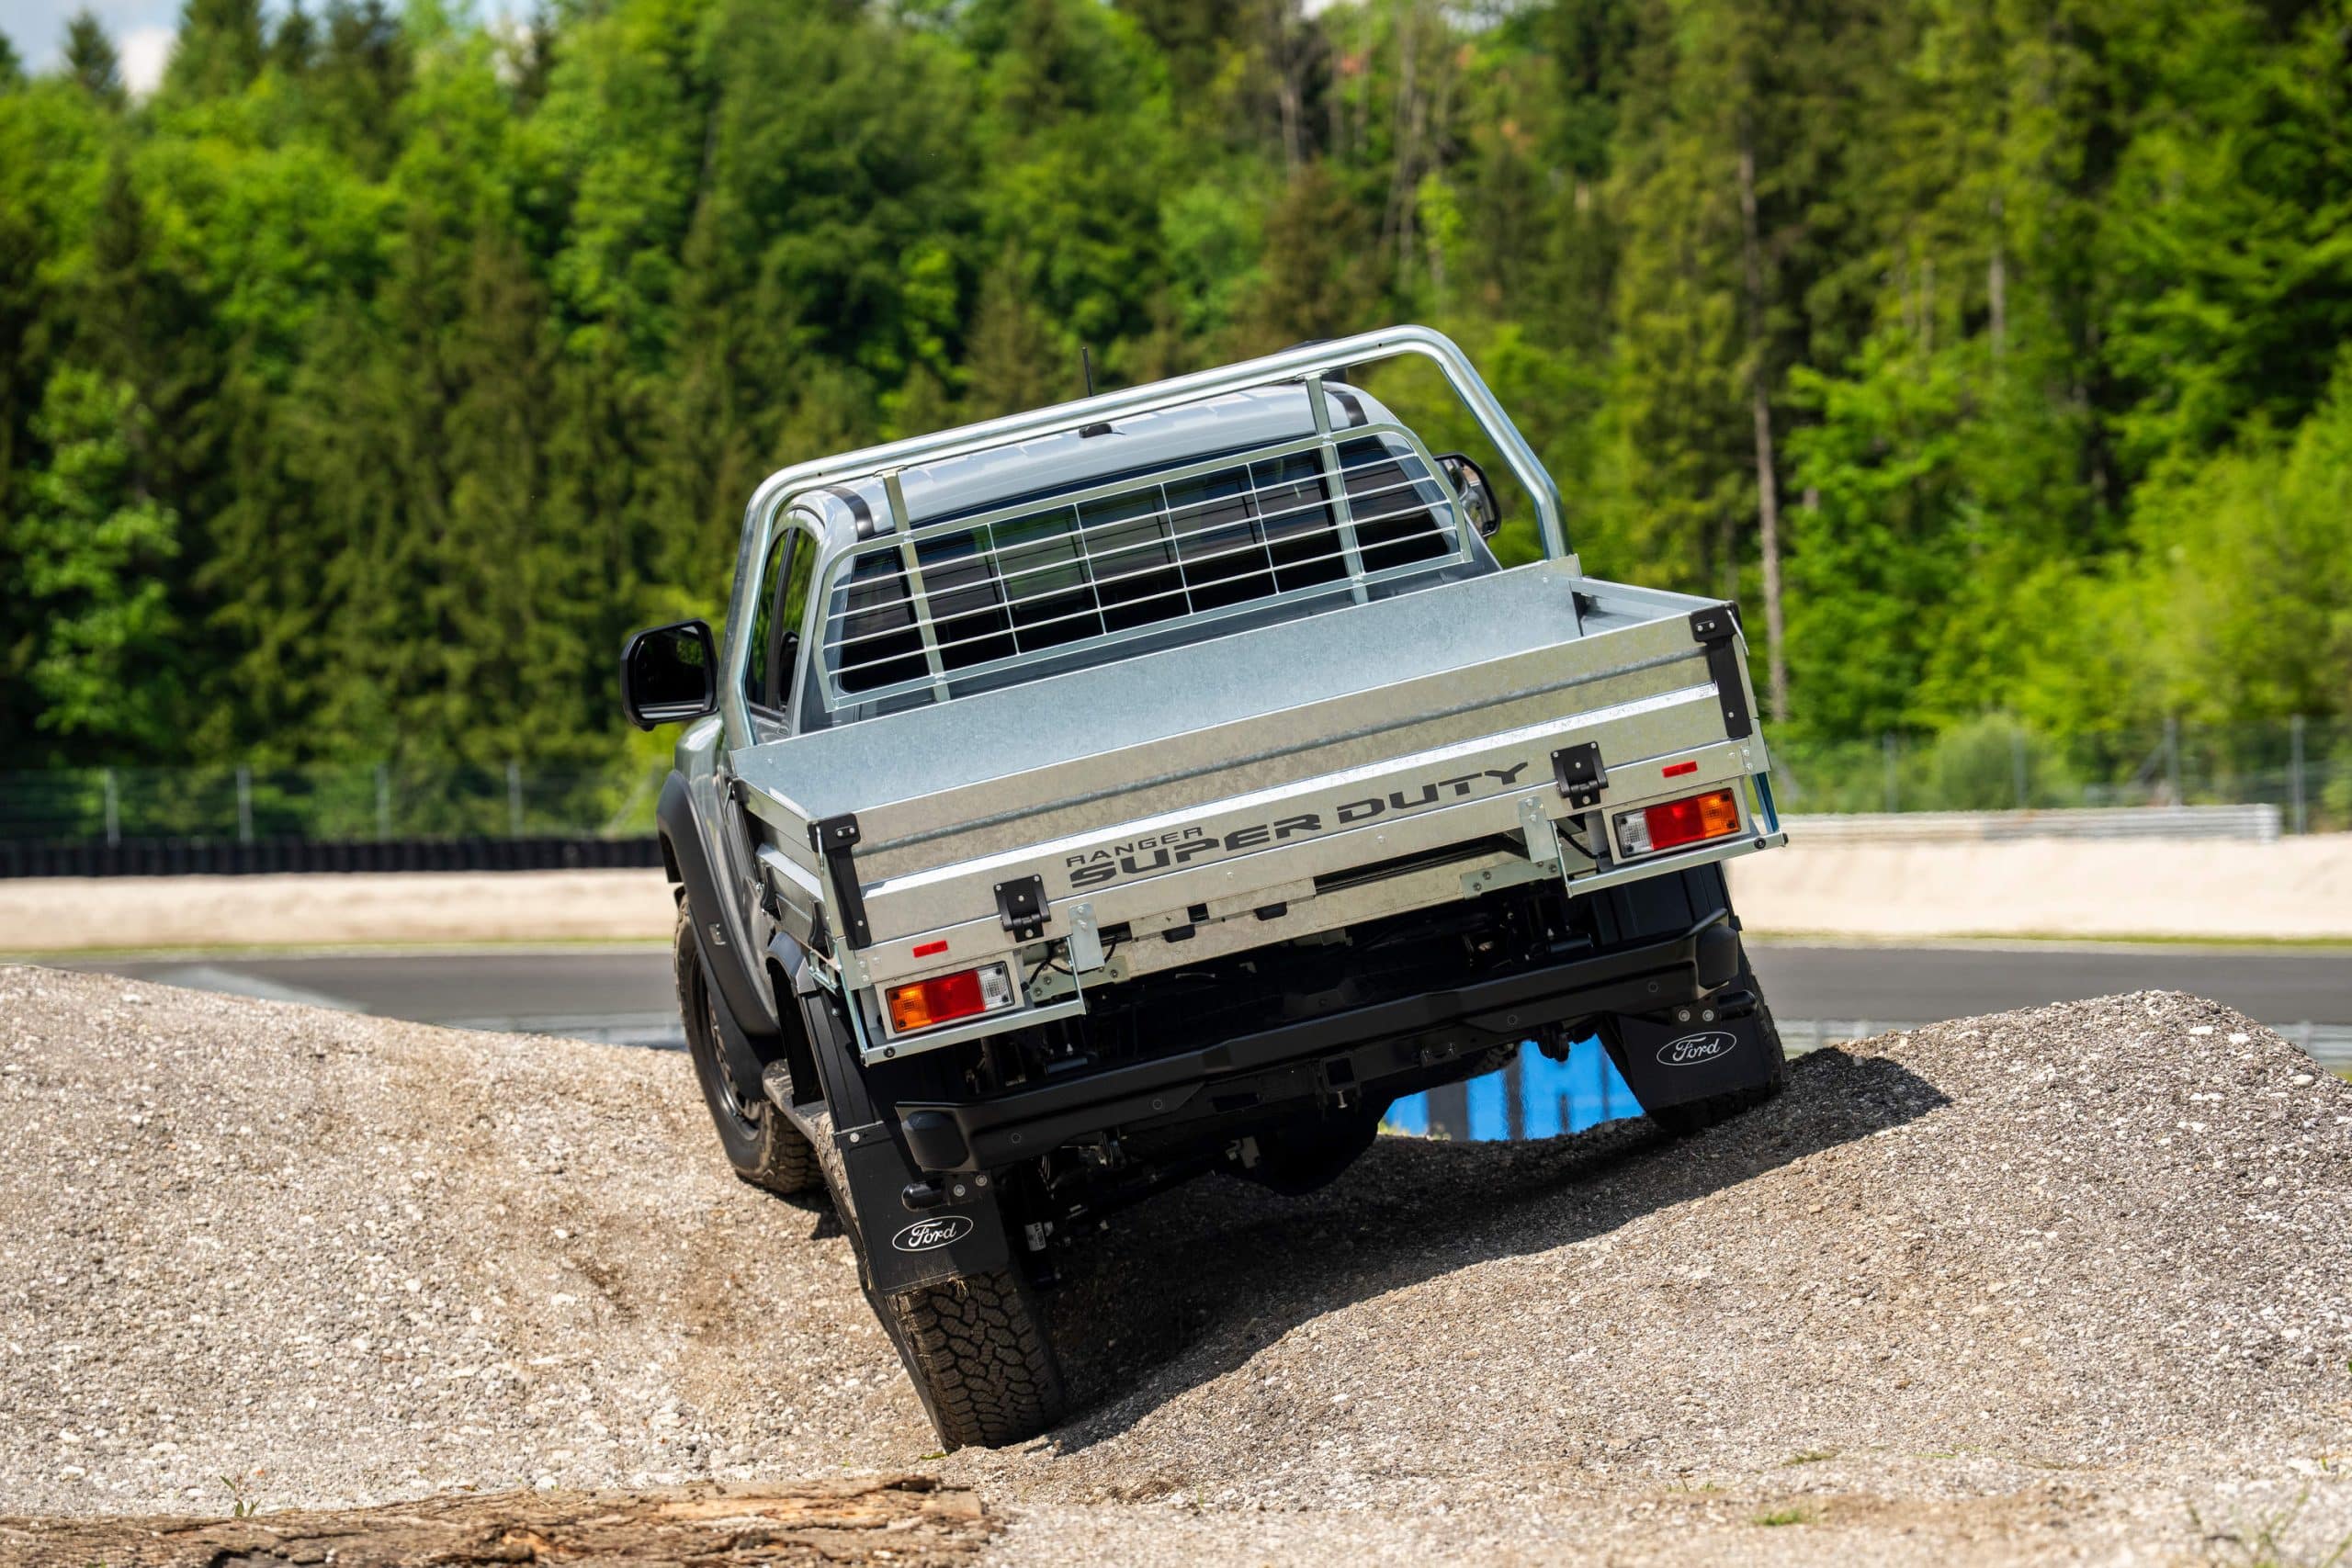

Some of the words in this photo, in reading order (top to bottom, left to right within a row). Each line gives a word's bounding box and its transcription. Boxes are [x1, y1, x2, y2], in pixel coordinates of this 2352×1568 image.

[1069, 813, 1323, 889] SUPER
[1336, 761, 1529, 825] DUTY
[1066, 826, 1203, 868] RANGER
[1672, 1035, 1721, 1062] Ford
[908, 1220, 957, 1248] Ford
